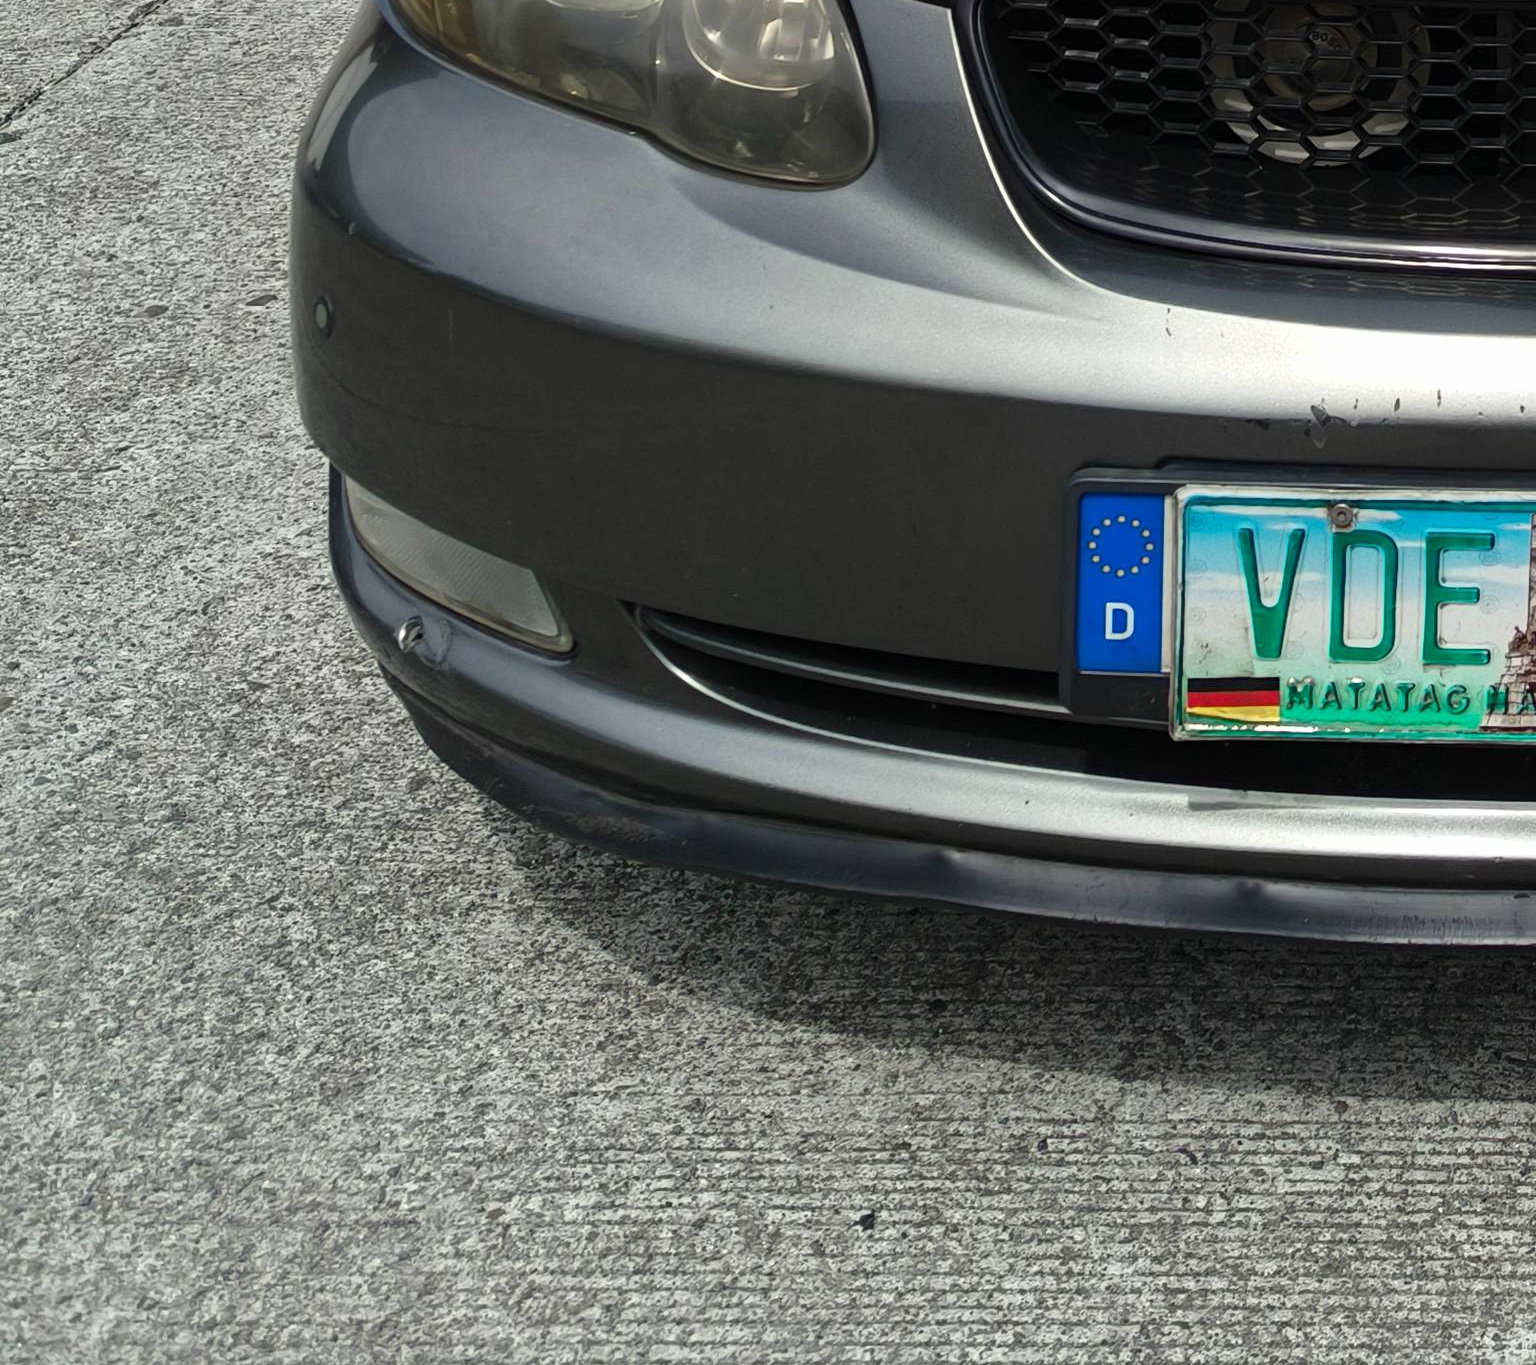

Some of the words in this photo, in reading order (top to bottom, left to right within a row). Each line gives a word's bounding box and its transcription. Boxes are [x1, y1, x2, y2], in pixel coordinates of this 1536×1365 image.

[1238, 527, 1496, 665] VDE
[1104, 601, 1135, 640] D
[1286, 676, 1471, 715] MATATAG
